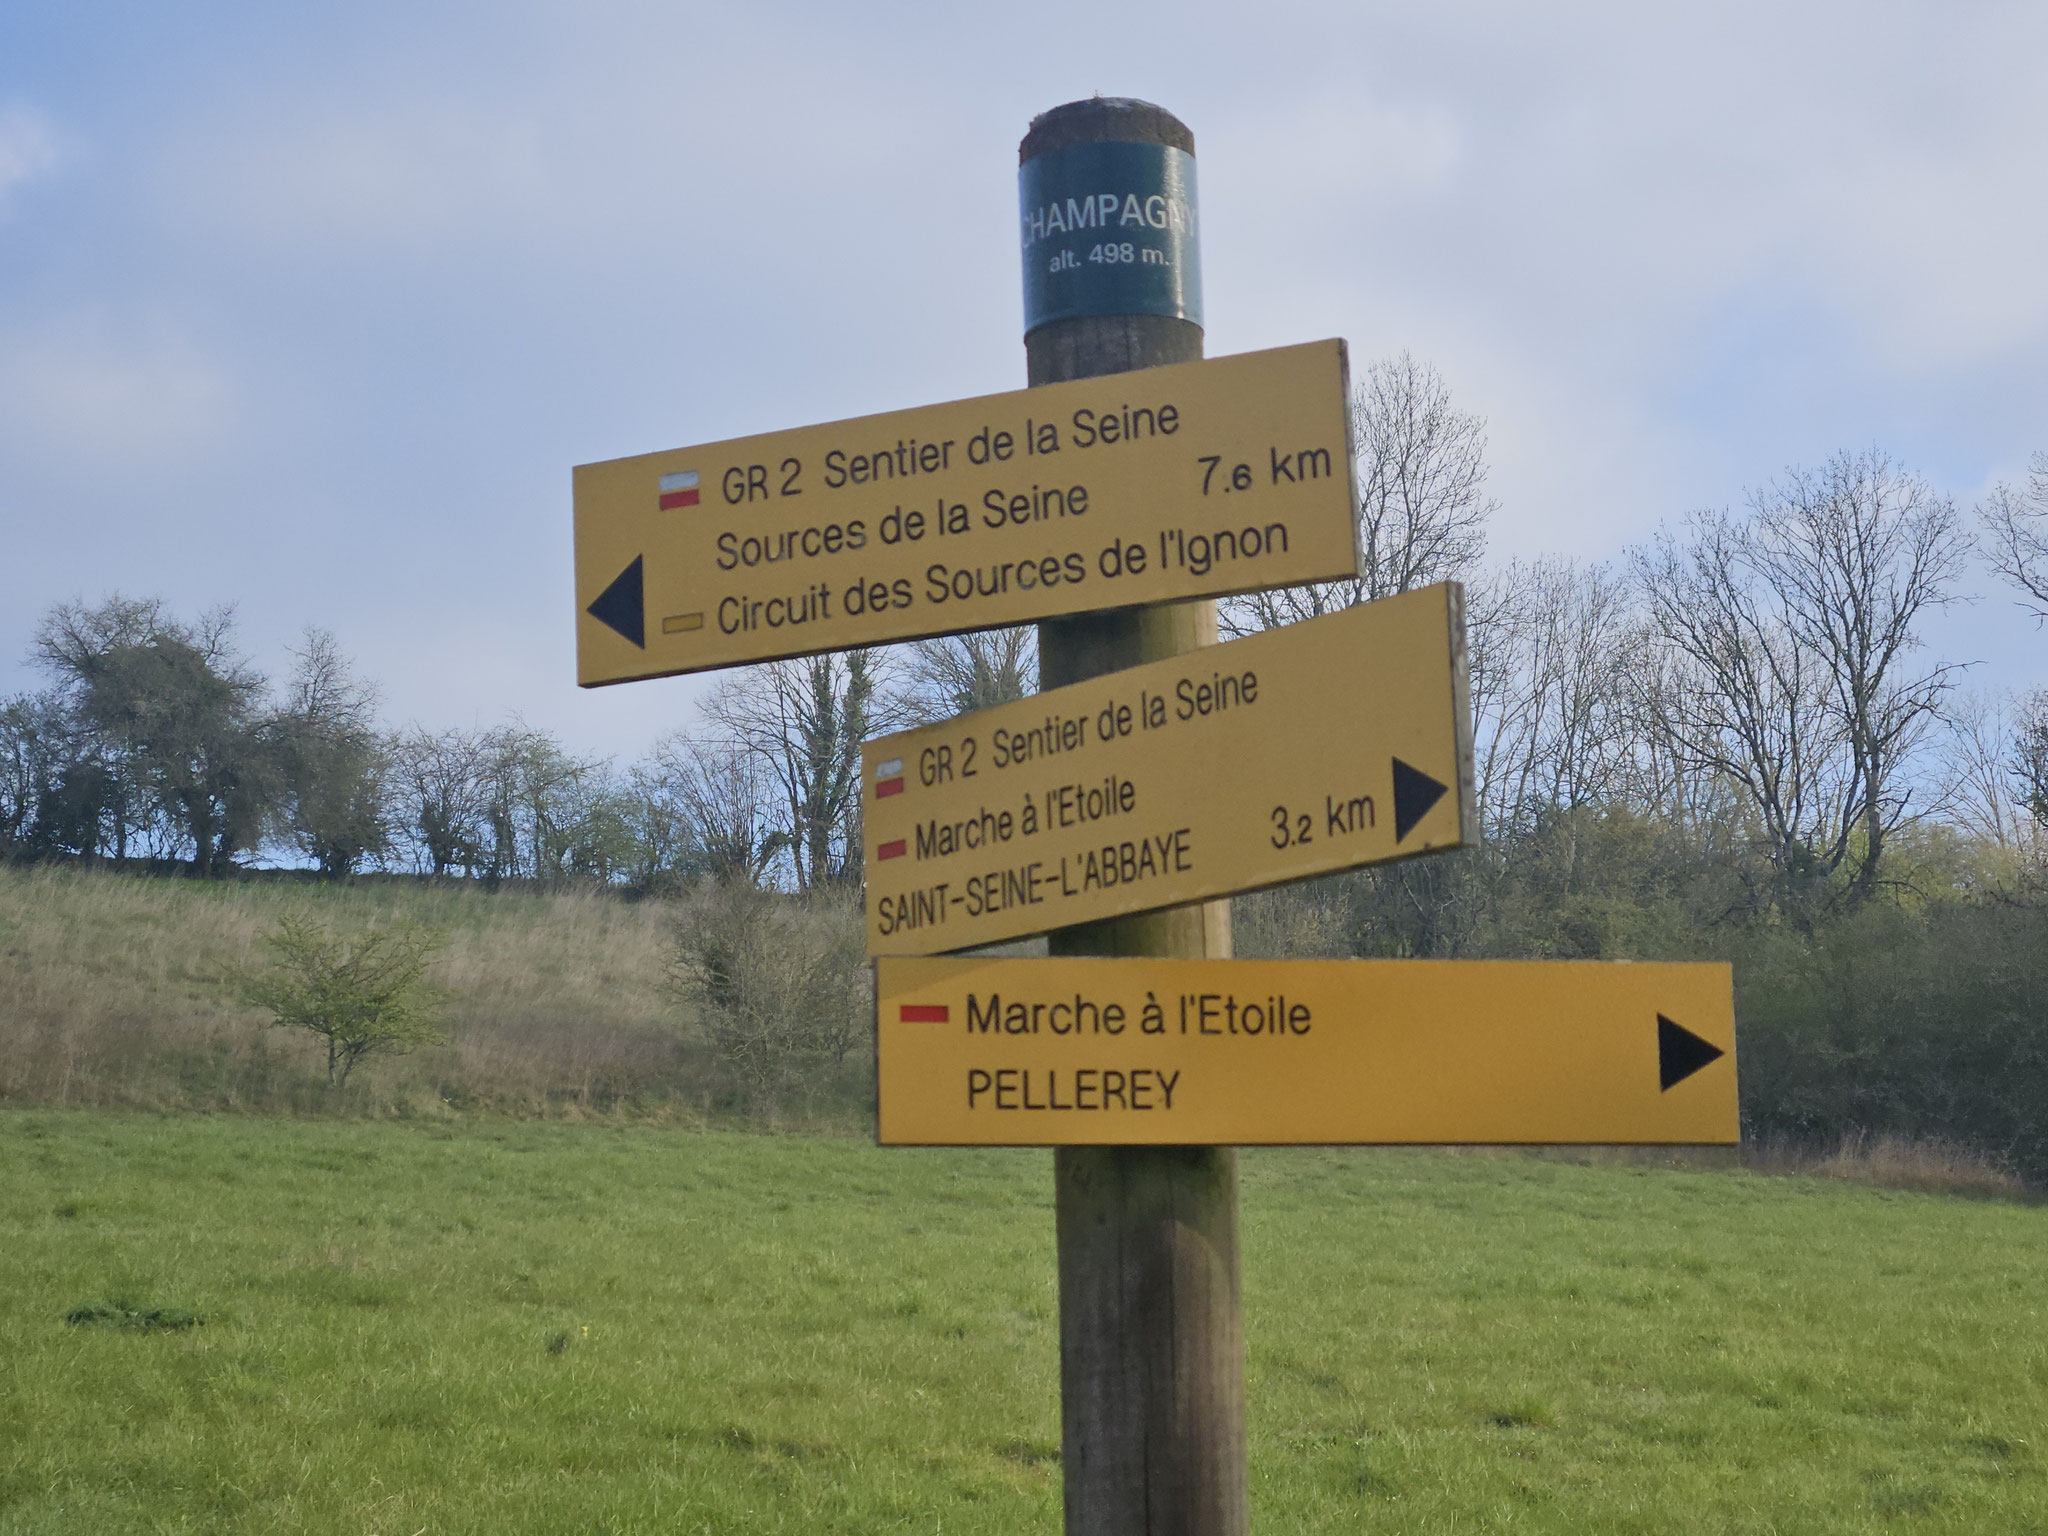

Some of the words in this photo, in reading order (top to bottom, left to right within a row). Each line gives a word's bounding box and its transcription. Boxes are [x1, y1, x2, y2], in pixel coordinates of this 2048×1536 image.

[1049, 250, 1082, 273] alt.
[1089, 242, 1135, 265] 498
[1141, 248, 1171, 266] m.
[722, 464, 769, 505] GR
[780, 457, 803, 497] 2
[823, 439, 955, 489] Sentier
[967, 425, 1014, 466] de
[1026, 418, 1061, 456] la
[1072, 403, 1180, 449] Seine
[1197, 455, 1253, 496] 7.6
[1270, 446, 1332, 485] km
[716, 519, 867, 571] Sources
[878, 505, 926, 545] de
[938, 498, 972, 536] la
[982, 484, 1089, 529] Seine
[717, 582, 832, 636] Circuit
[843, 576, 913, 617] des
[925, 552, 1087, 604] Sources
[1098, 537, 1147, 579] de
[1159, 522, 1289, 577] l'Ignon
[919, 745, 954, 788] GR
[961, 737, 978, 778] 2
[993, 715, 1089, 769] Sentier
[1097, 700, 1133, 743] de
[1141, 690, 1168, 730] la
[1175, 671, 1258, 722] Seine
[915, 807, 1014, 861] Marche
[1021, 792, 1039, 836] à
[1046, 775, 1136, 830] l'Etoile
[1270, 804, 1313, 851] 3.2
[1326, 795, 1376, 838] km
[878, 828, 1193, 936] SAINT-SEINE-L'ABBAYE
[966, 993, 1126, 1036] Marche
[1139, 990, 1166, 1036] à
[1179, 993, 1312, 1037] l'Etoile
[967, 1068, 1181, 1112] PELLEREY
